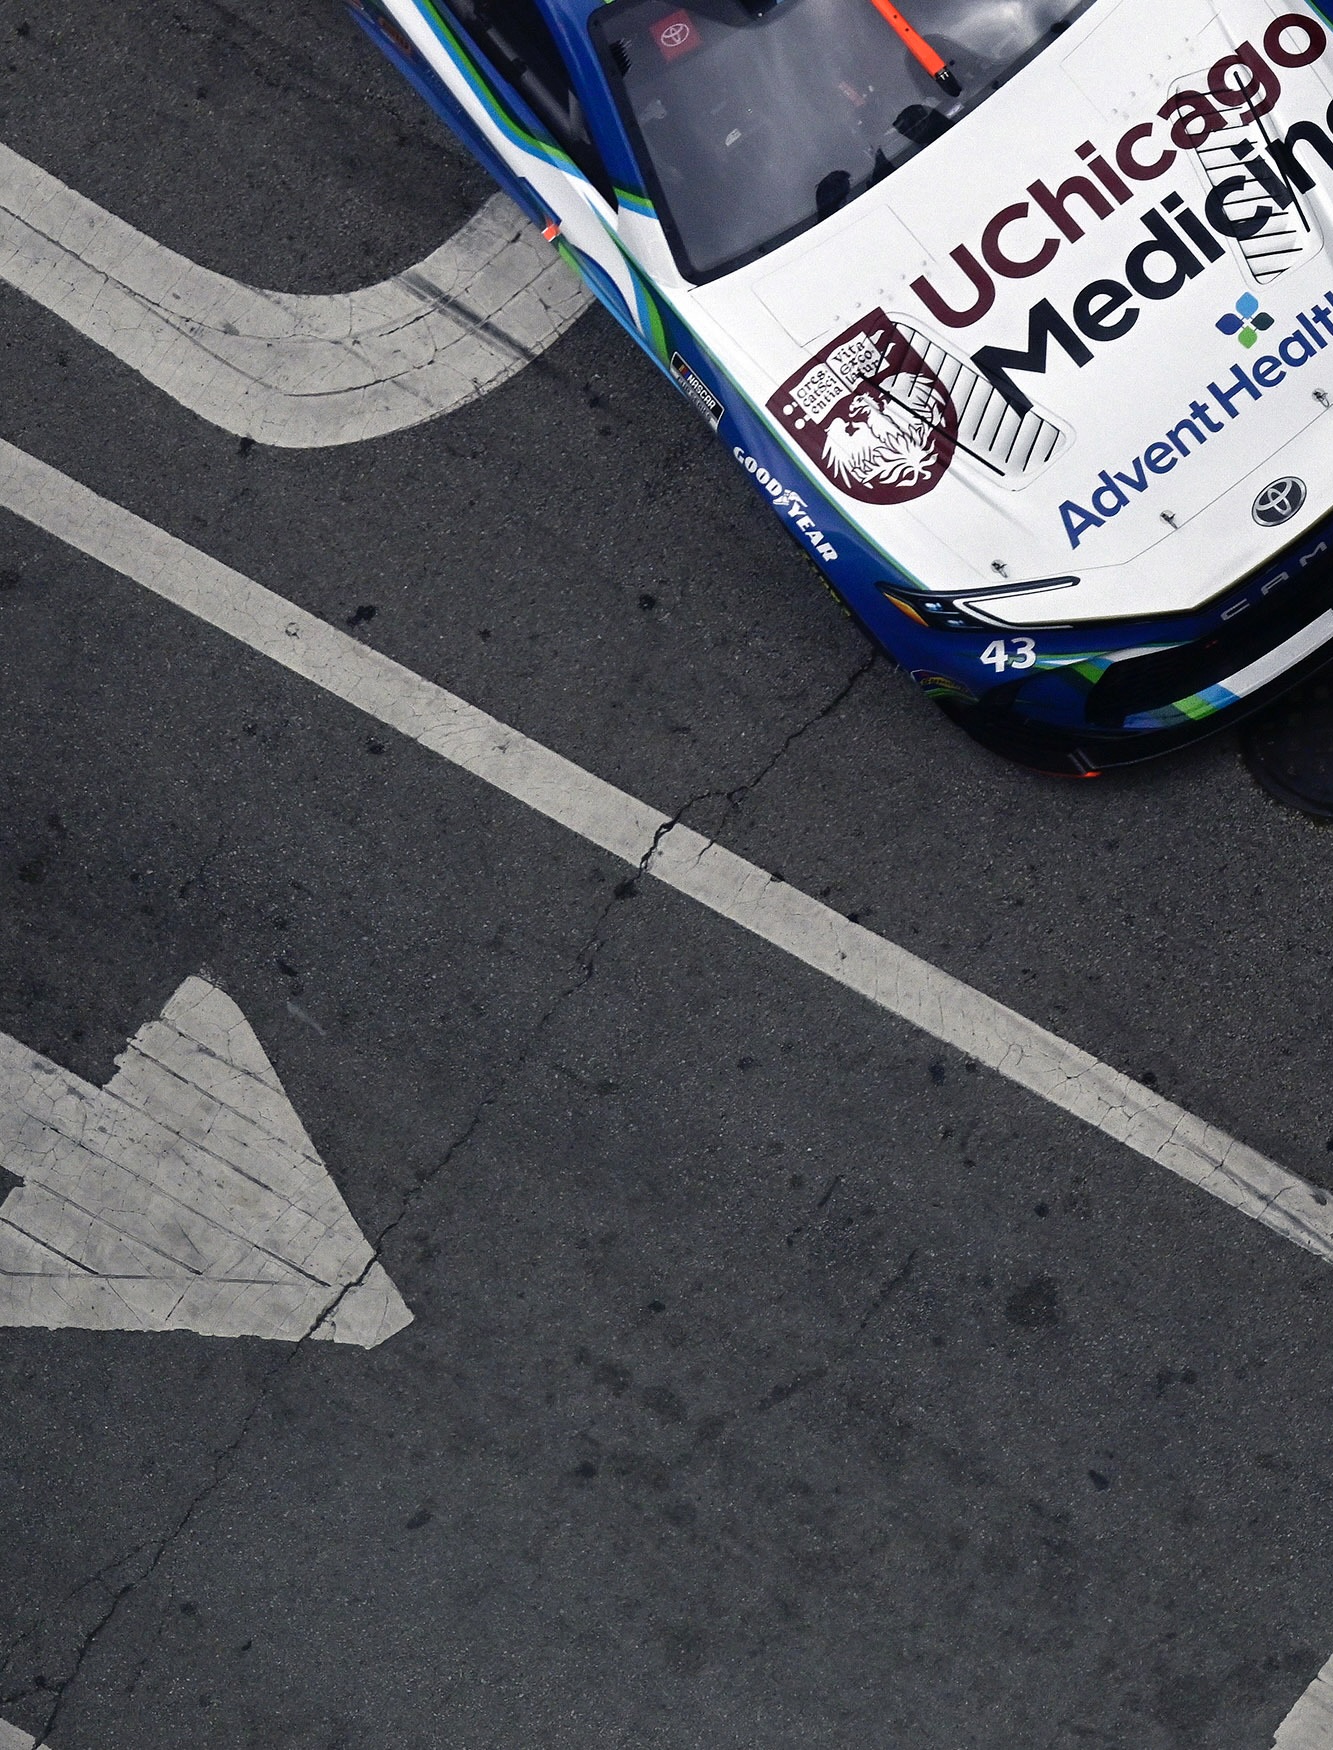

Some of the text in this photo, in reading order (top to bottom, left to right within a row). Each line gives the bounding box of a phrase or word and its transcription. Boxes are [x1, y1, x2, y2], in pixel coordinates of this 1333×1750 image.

[909, 13, 1327, 329] UChicago
[687, 374, 716, 410] NASCAR
[733, 446, 838, 562] GOODYEAR
[980, 637, 1038, 673] 43
